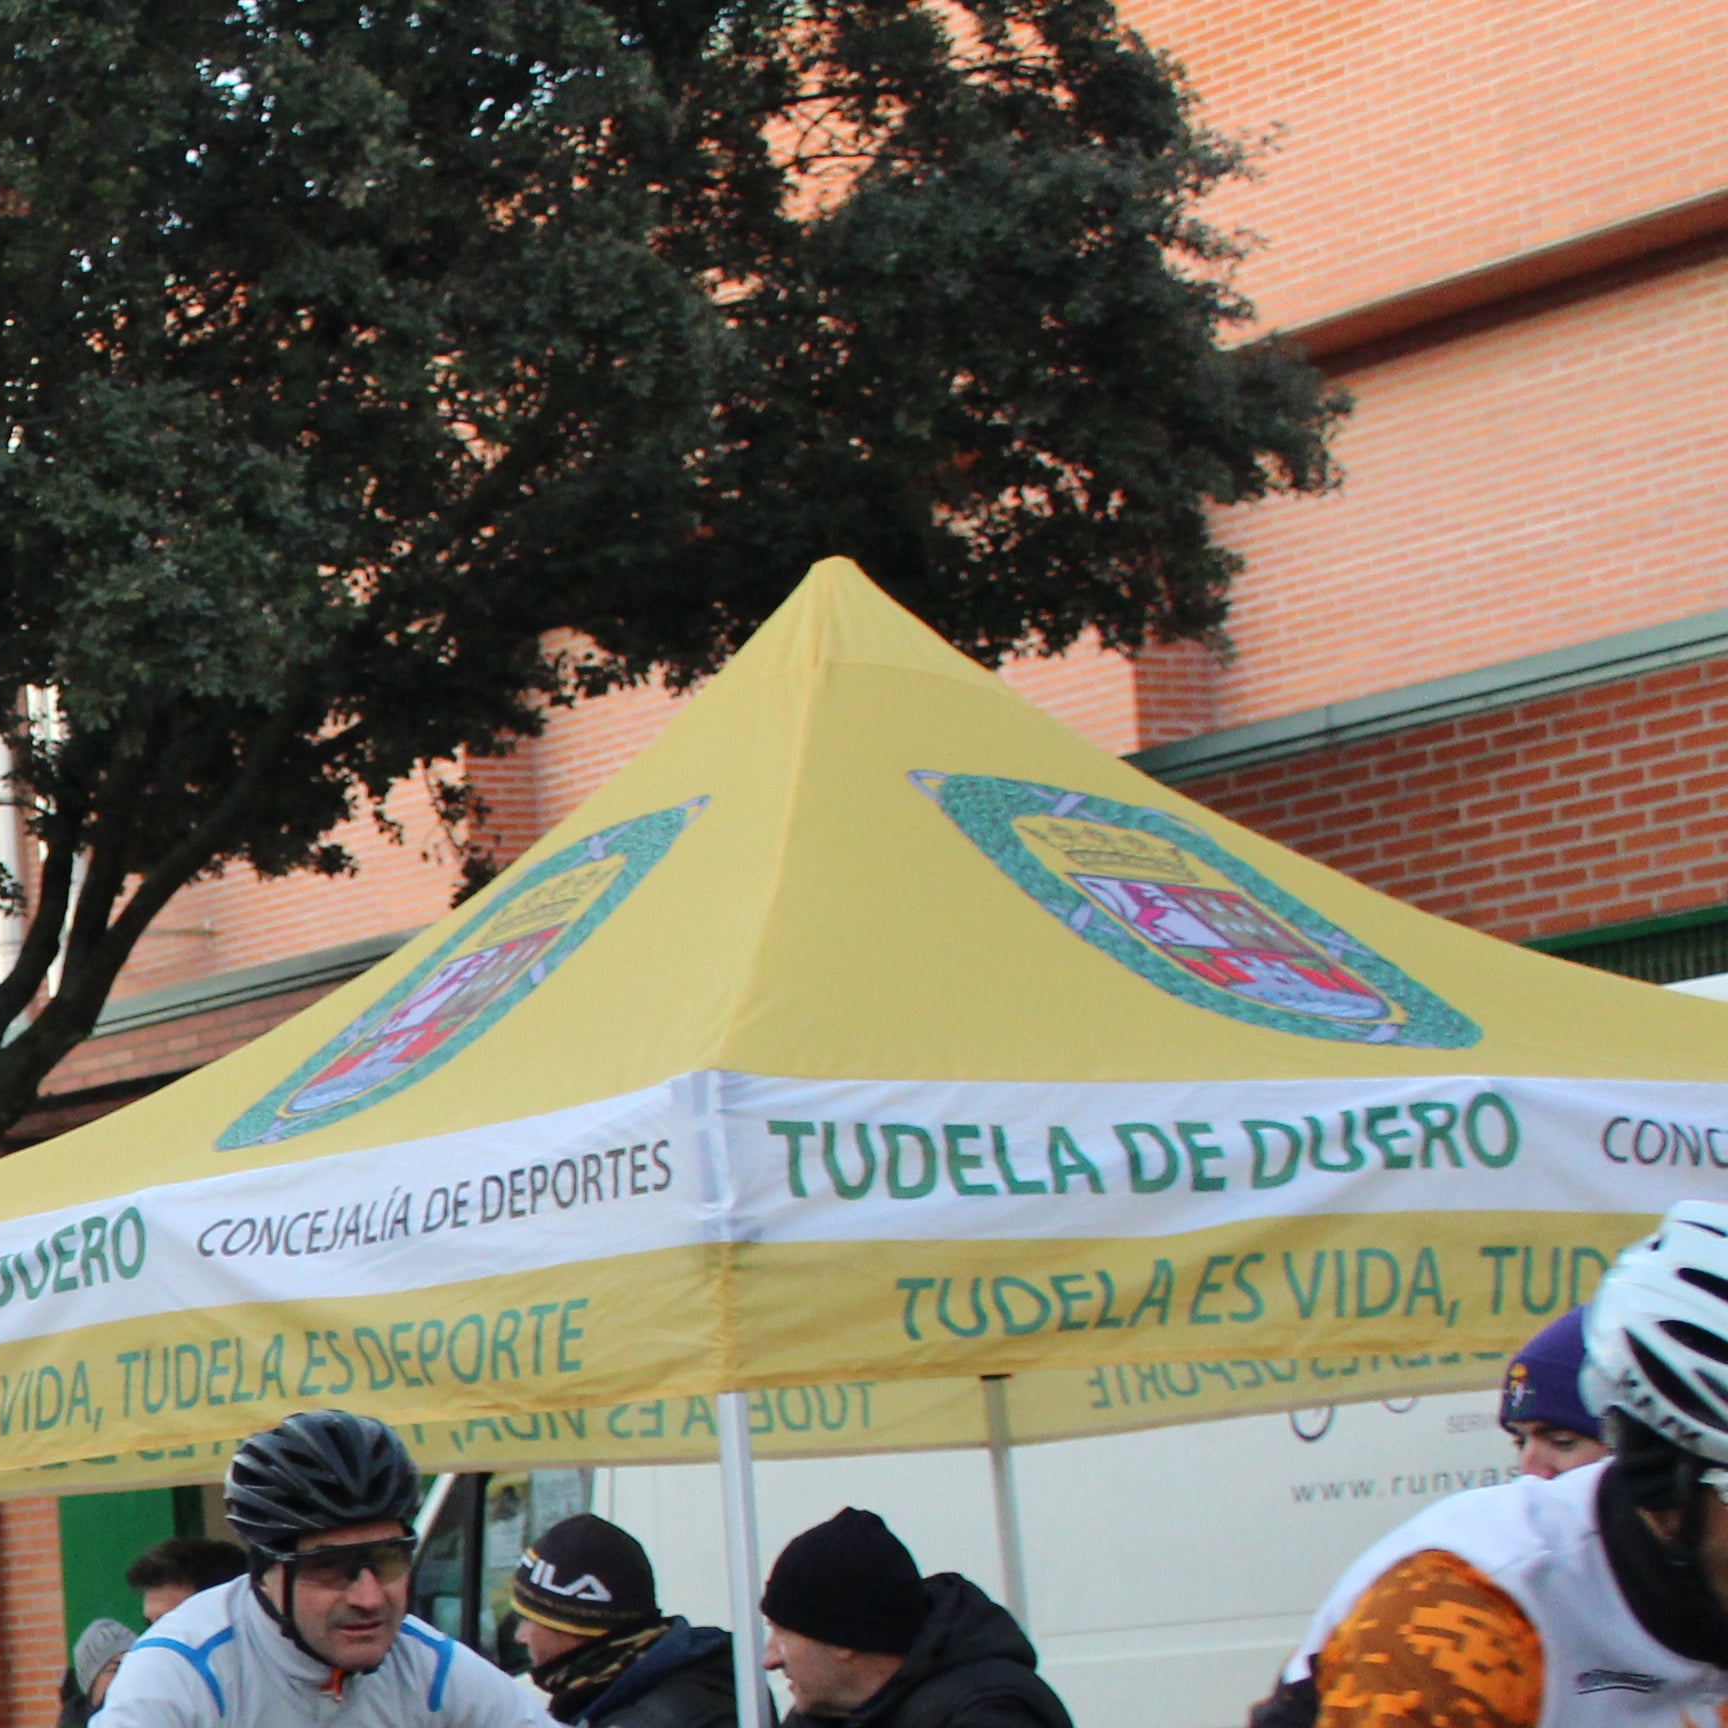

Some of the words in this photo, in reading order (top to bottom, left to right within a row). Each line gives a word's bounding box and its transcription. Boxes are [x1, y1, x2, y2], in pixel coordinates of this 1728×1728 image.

[197, 1185, 410, 1258] CONCEJALÍA
[421, 1180, 472, 1234] DE
[479, 1138, 674, 1225] DEPORTES
[767, 1121, 1106, 1200] TUDELA
[1114, 1122, 1229, 1195] DE
[1240, 1091, 1521, 1191] DUERO
[896, 1258, 1175, 1341] TUDELA
[1188, 1252, 1265, 1325] ES
[1283, 1245, 1463, 1328] VIDA,
[0, 1360, 105, 1434] VIDA,
[116, 1332, 285, 1418] TUDELA
[297, 1328, 355, 1396] ES
[352, 1297, 589, 1392] DEPORTE
